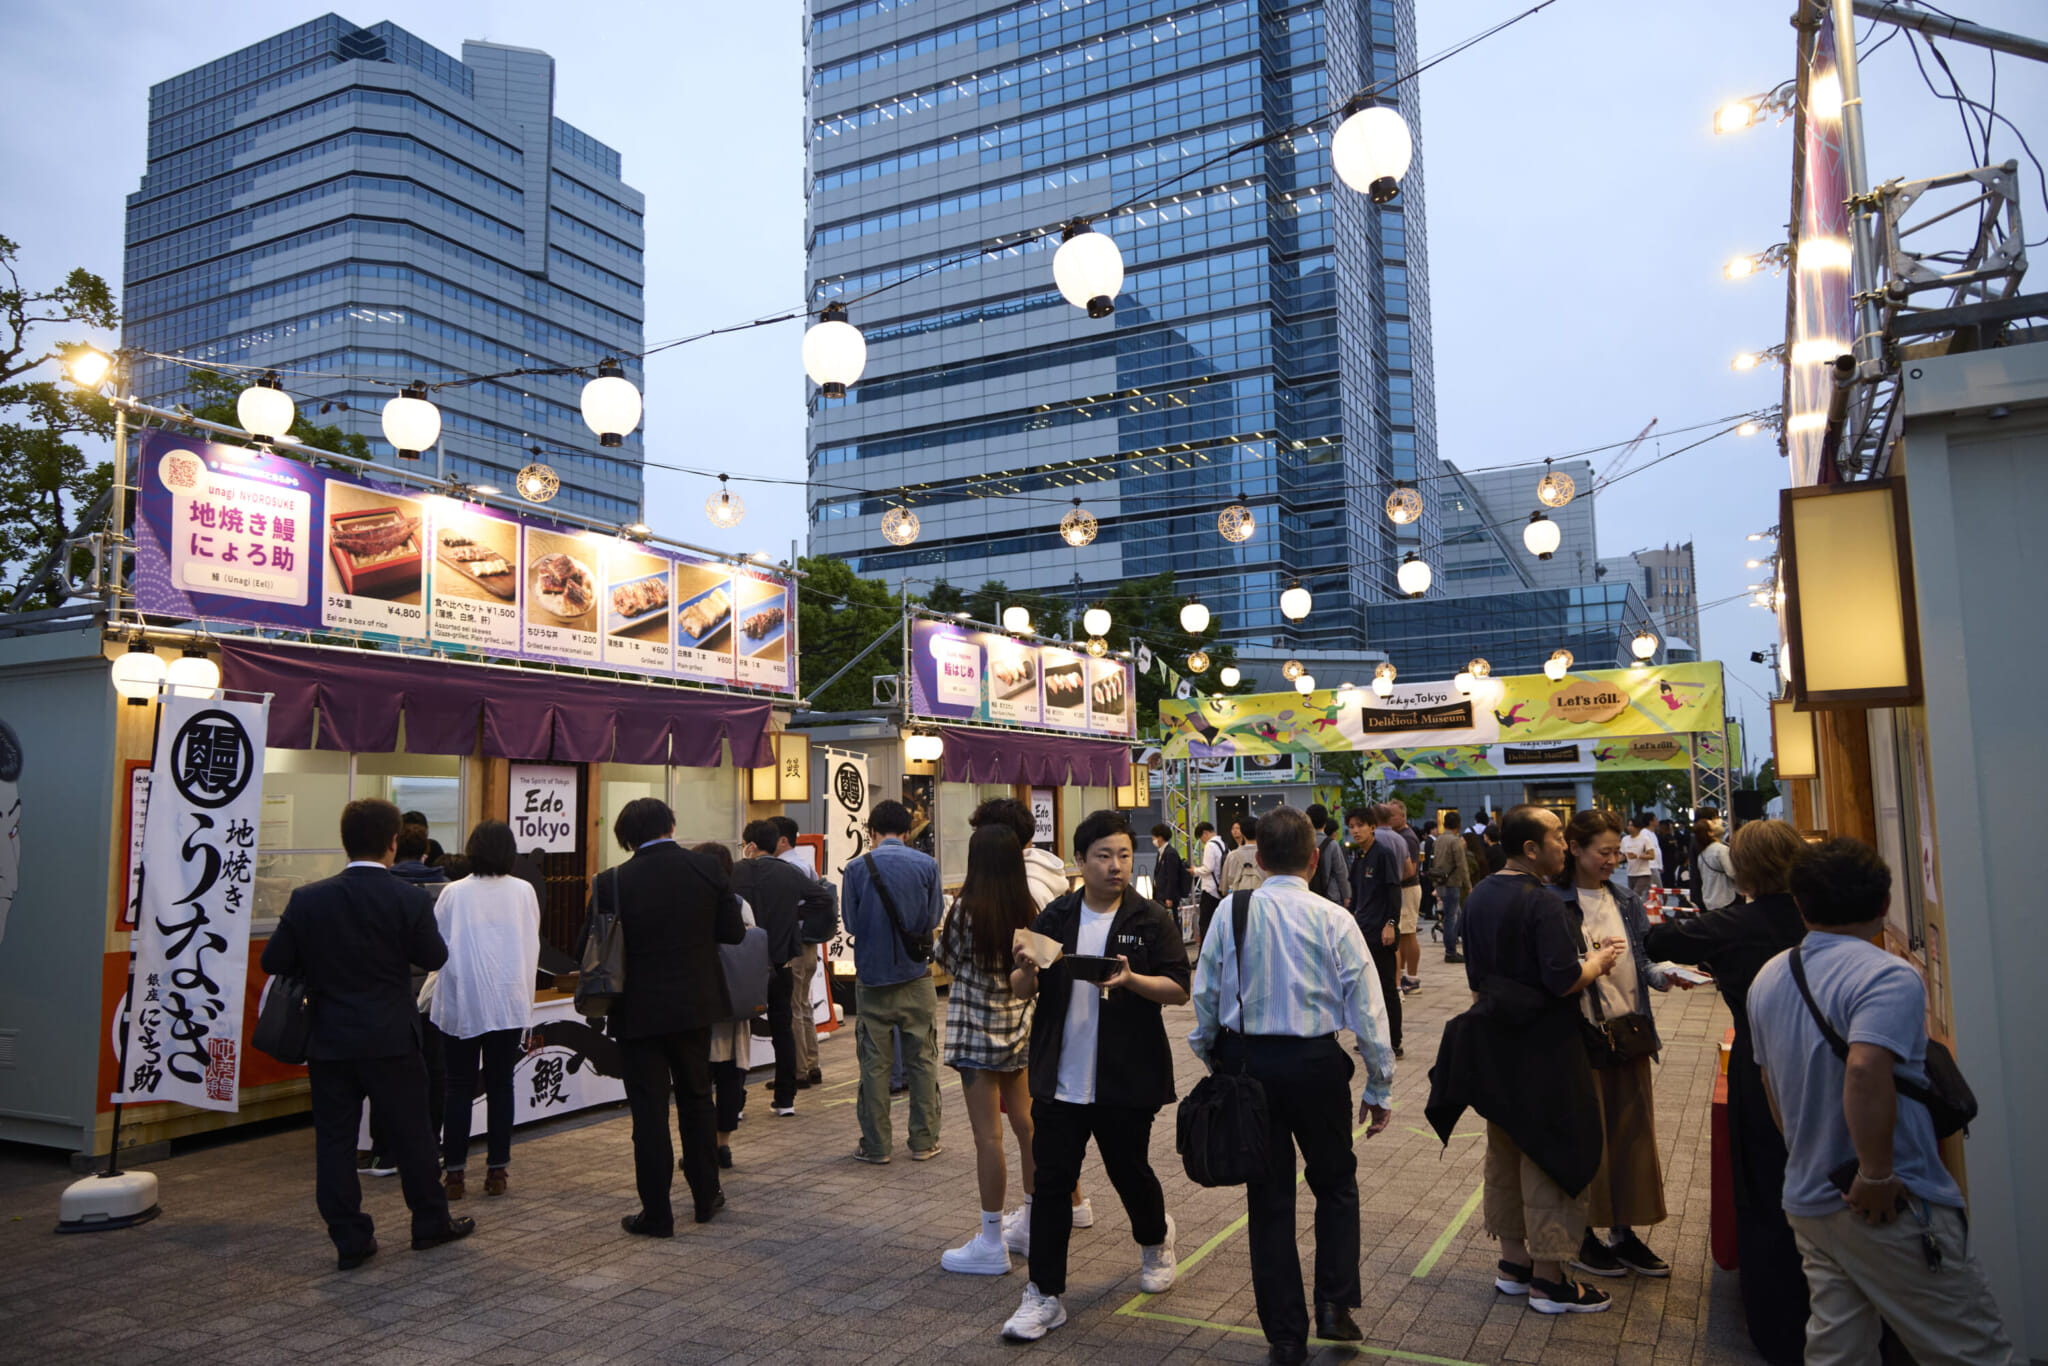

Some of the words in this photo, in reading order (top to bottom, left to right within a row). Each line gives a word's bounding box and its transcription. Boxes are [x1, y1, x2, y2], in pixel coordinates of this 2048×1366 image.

[208, 485, 235, 501] unagi
[240, 489, 295, 511] NYOROSUKE
[189, 500, 295, 543] 地焼き鰻
[190, 532, 294, 572] にょろ助
[328, 597, 352, 609] うな重
[388, 606, 420, 619] ¥4,800
[434, 598, 485, 614] 食べ比べセット
[486, 606, 516, 618] ¥1,500
[327, 614, 337, 622] Eel
[339, 615, 348, 623] on
[354, 617, 366, 625] box
[367, 619, 375, 627] of
[376, 621, 388, 629] rice
[434, 621, 461, 631] Assorted
[1415, 693, 1448, 705] Tokyo
[1557, 695, 1591, 707] Let's
[1368, 714, 1418, 728] Delicious
[1421, 712, 1466, 725] Museum
[524, 788, 564, 813] Edo
[1035, 804, 1049, 818] Edo
[515, 816, 570, 843] Tokyo
[220, 818, 255, 915] 地焼き
[155, 812, 228, 1084] うなぎ
[529, 1056, 571, 1108] 鰻
